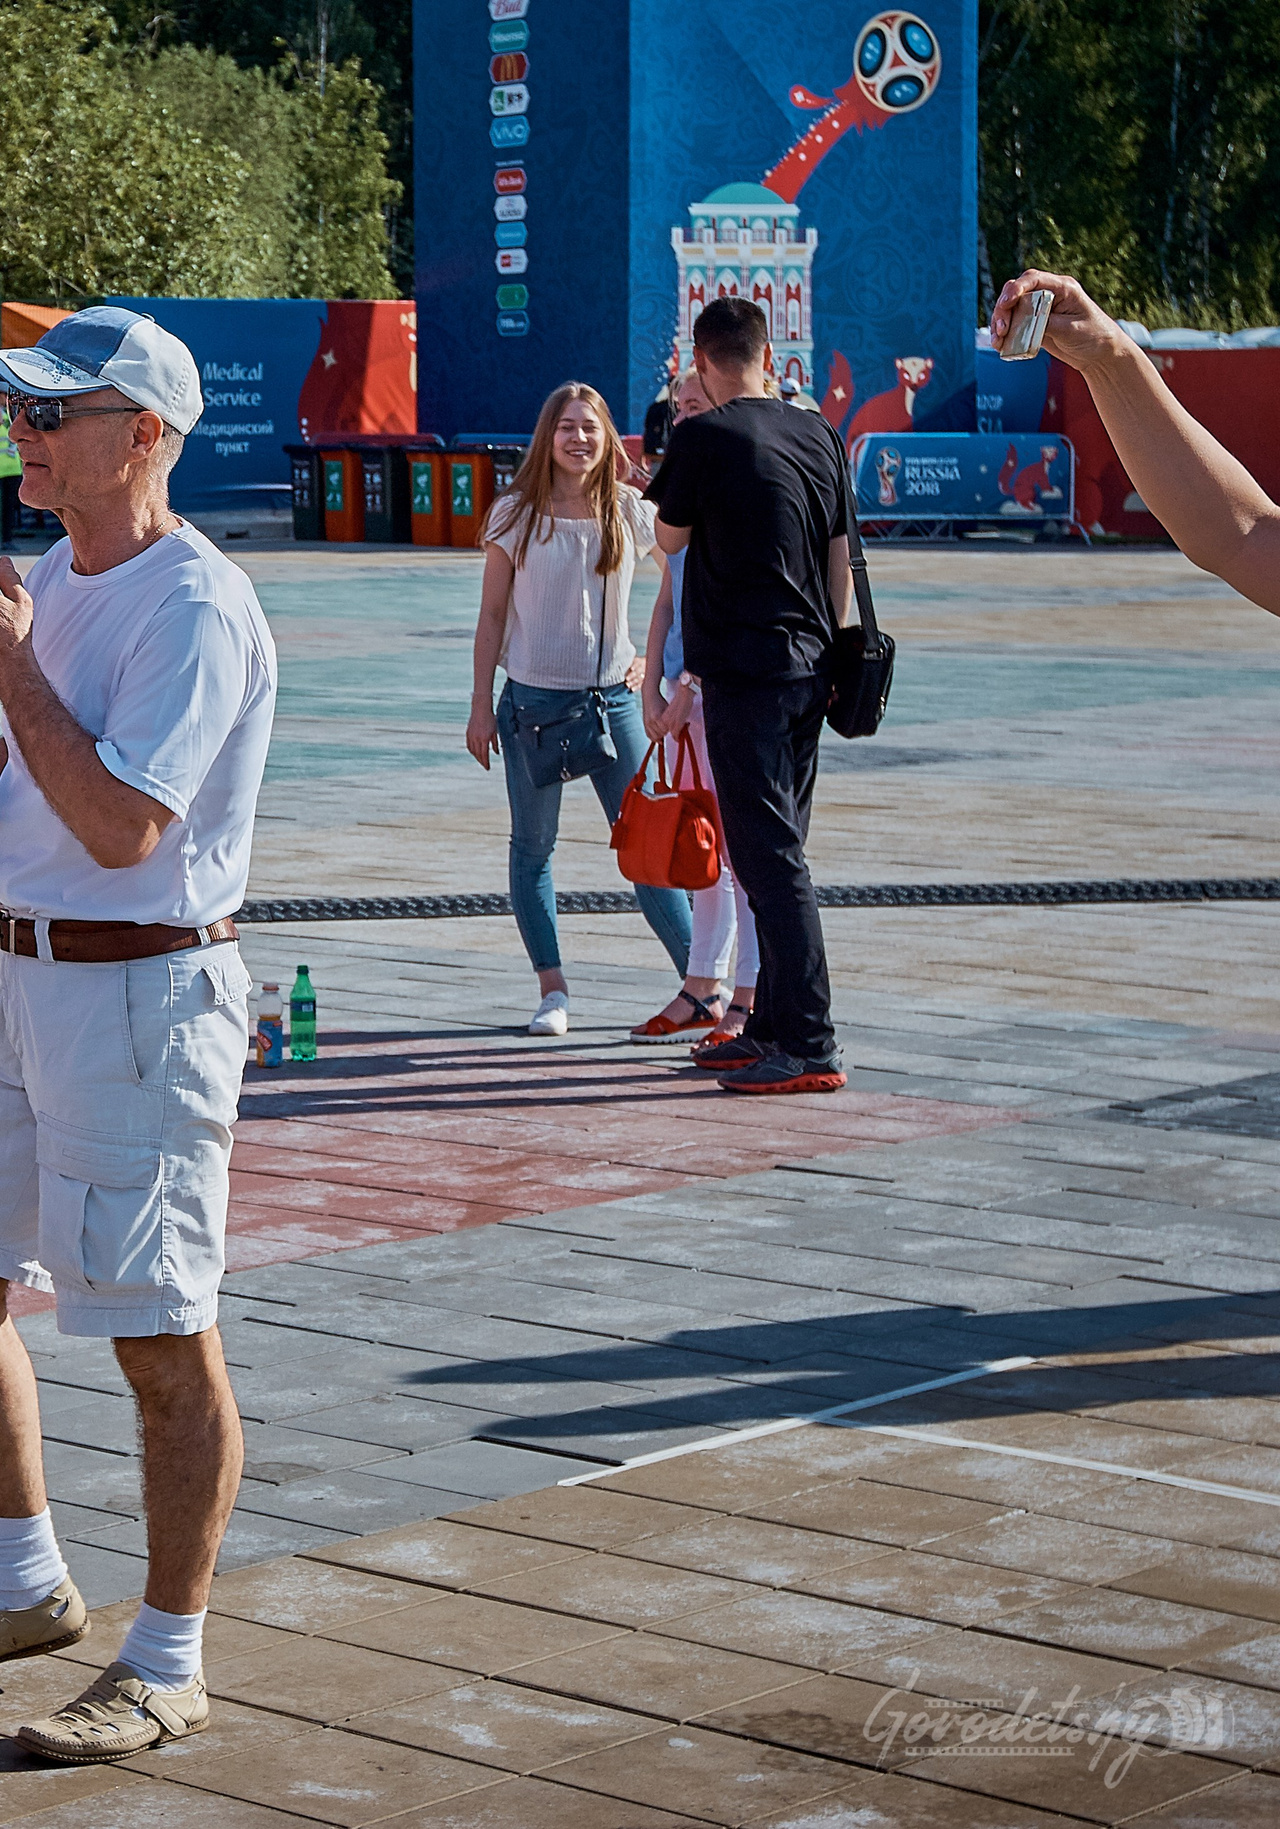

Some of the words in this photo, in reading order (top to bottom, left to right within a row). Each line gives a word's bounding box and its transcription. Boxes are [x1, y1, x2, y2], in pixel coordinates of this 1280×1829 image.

[203, 362, 263, 381] Medical
[203, 387, 262, 407] Service
[216, 442, 249, 457] пункт
[904, 466, 961, 481] RUSSIA
[904, 480, 941, 496] 2018
